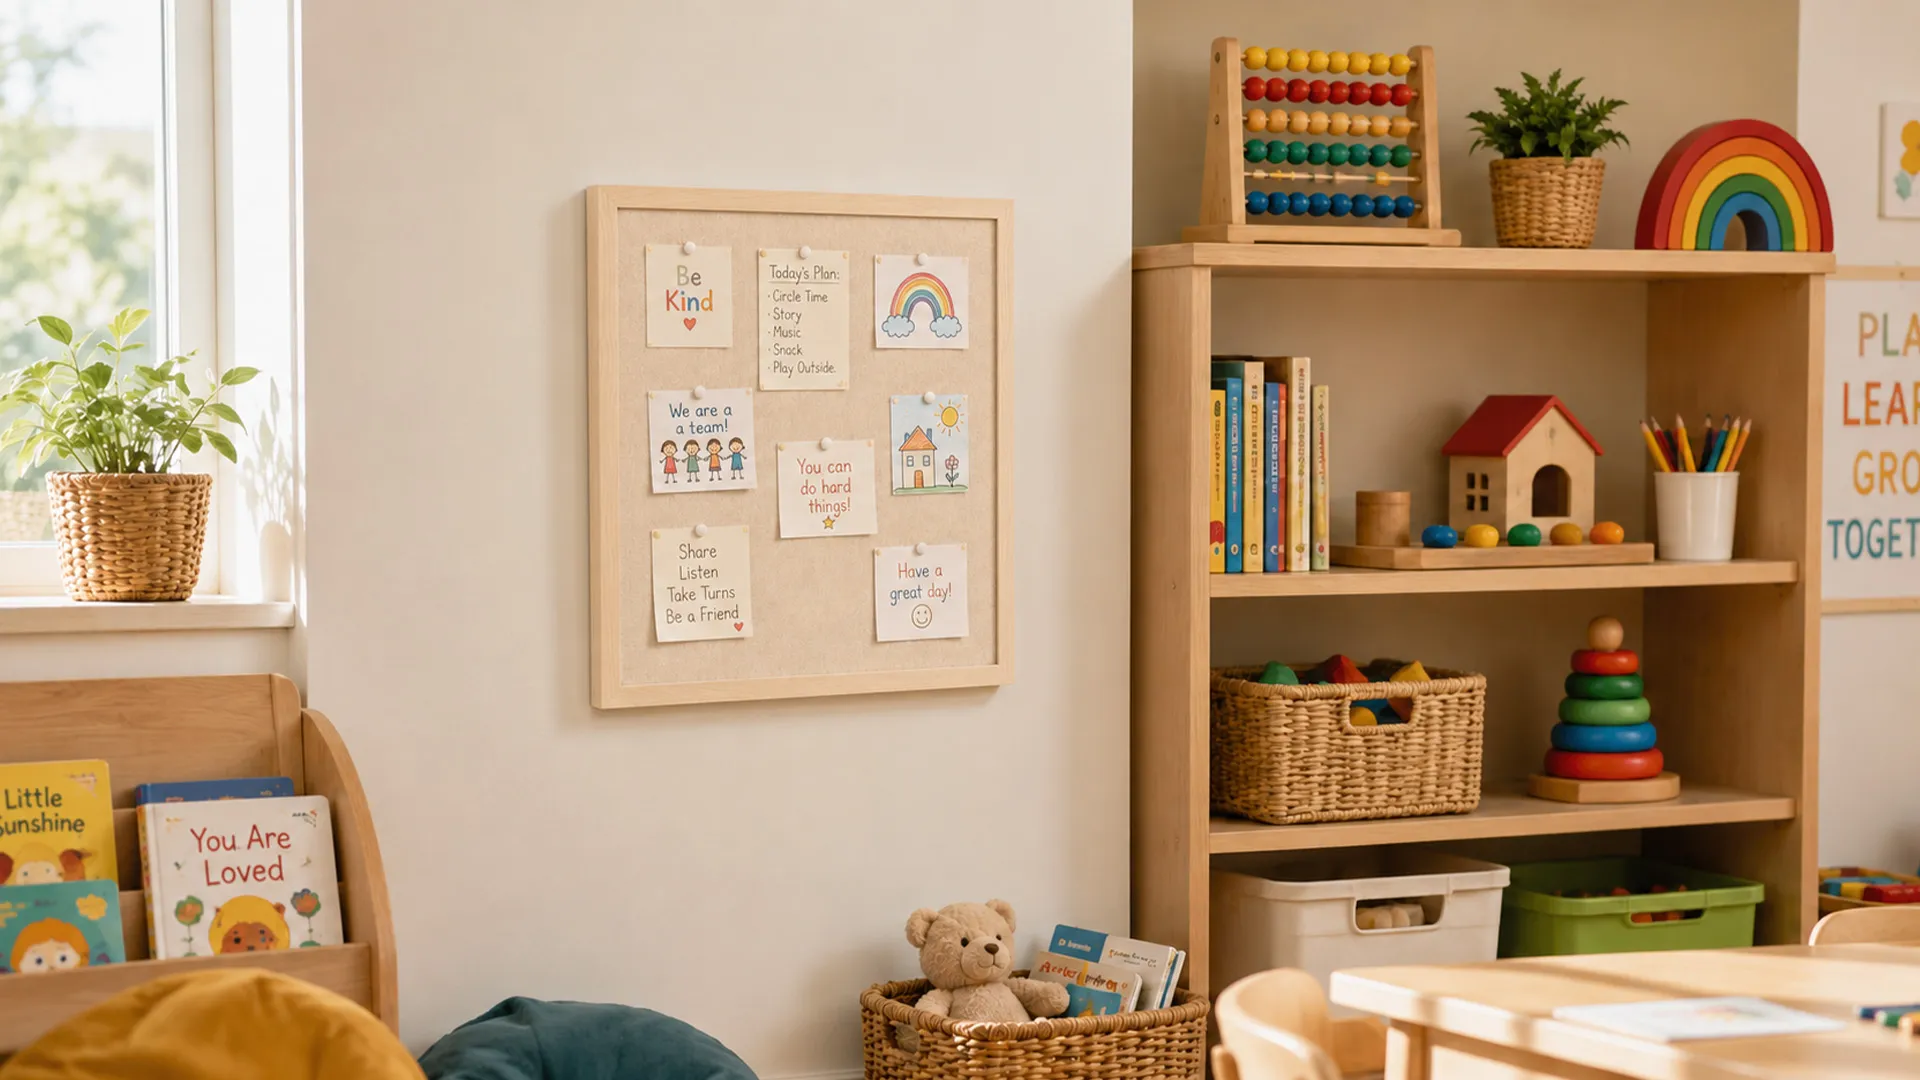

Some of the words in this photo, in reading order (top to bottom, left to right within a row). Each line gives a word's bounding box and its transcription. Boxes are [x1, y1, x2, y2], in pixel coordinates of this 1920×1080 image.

[677, 265, 701, 286] Be
[769, 264, 809, 285] Today's
[813, 265, 840, 280] Plan:
[666, 289, 713, 311] Kind
[772, 289, 801, 302] Circle
[805, 289, 828, 302] Time
[773, 307, 802, 324] Story
[773, 325, 801, 338] Music
[773, 343, 803, 356] Snack
[773, 360, 794, 378] Play
[669, 402, 690, 418] We
[695, 406, 718, 417] are
[723, 406, 733, 416] a
[676, 425, 684, 434] a
[689, 418, 728, 435] team!
[797, 458, 822, 475] You
[827, 462, 852, 474] can
[1853, 449, 1920, 495] GRO
[800, 479, 816, 495] do
[821, 477, 851, 493] hard
[809, 496, 851, 518] things!
[1826, 518, 1920, 560] TOGET
[679, 543, 717, 560] Share
[679, 565, 718, 580] Listen
[897, 562, 930, 579] Have
[935, 567, 943, 577] a
[667, 586, 696, 602] Take
[700, 585, 736, 600] Turns
[890, 584, 922, 606] great
[927, 582, 952, 603] day!
[666, 608, 682, 624] Be
[688, 613, 696, 623] a
[700, 604, 739, 622] Friend
[4, 786, 62, 810] Little
[191, 827, 236, 853] You
[247, 823, 291, 850] Are
[204, 855, 284, 887] Loved
